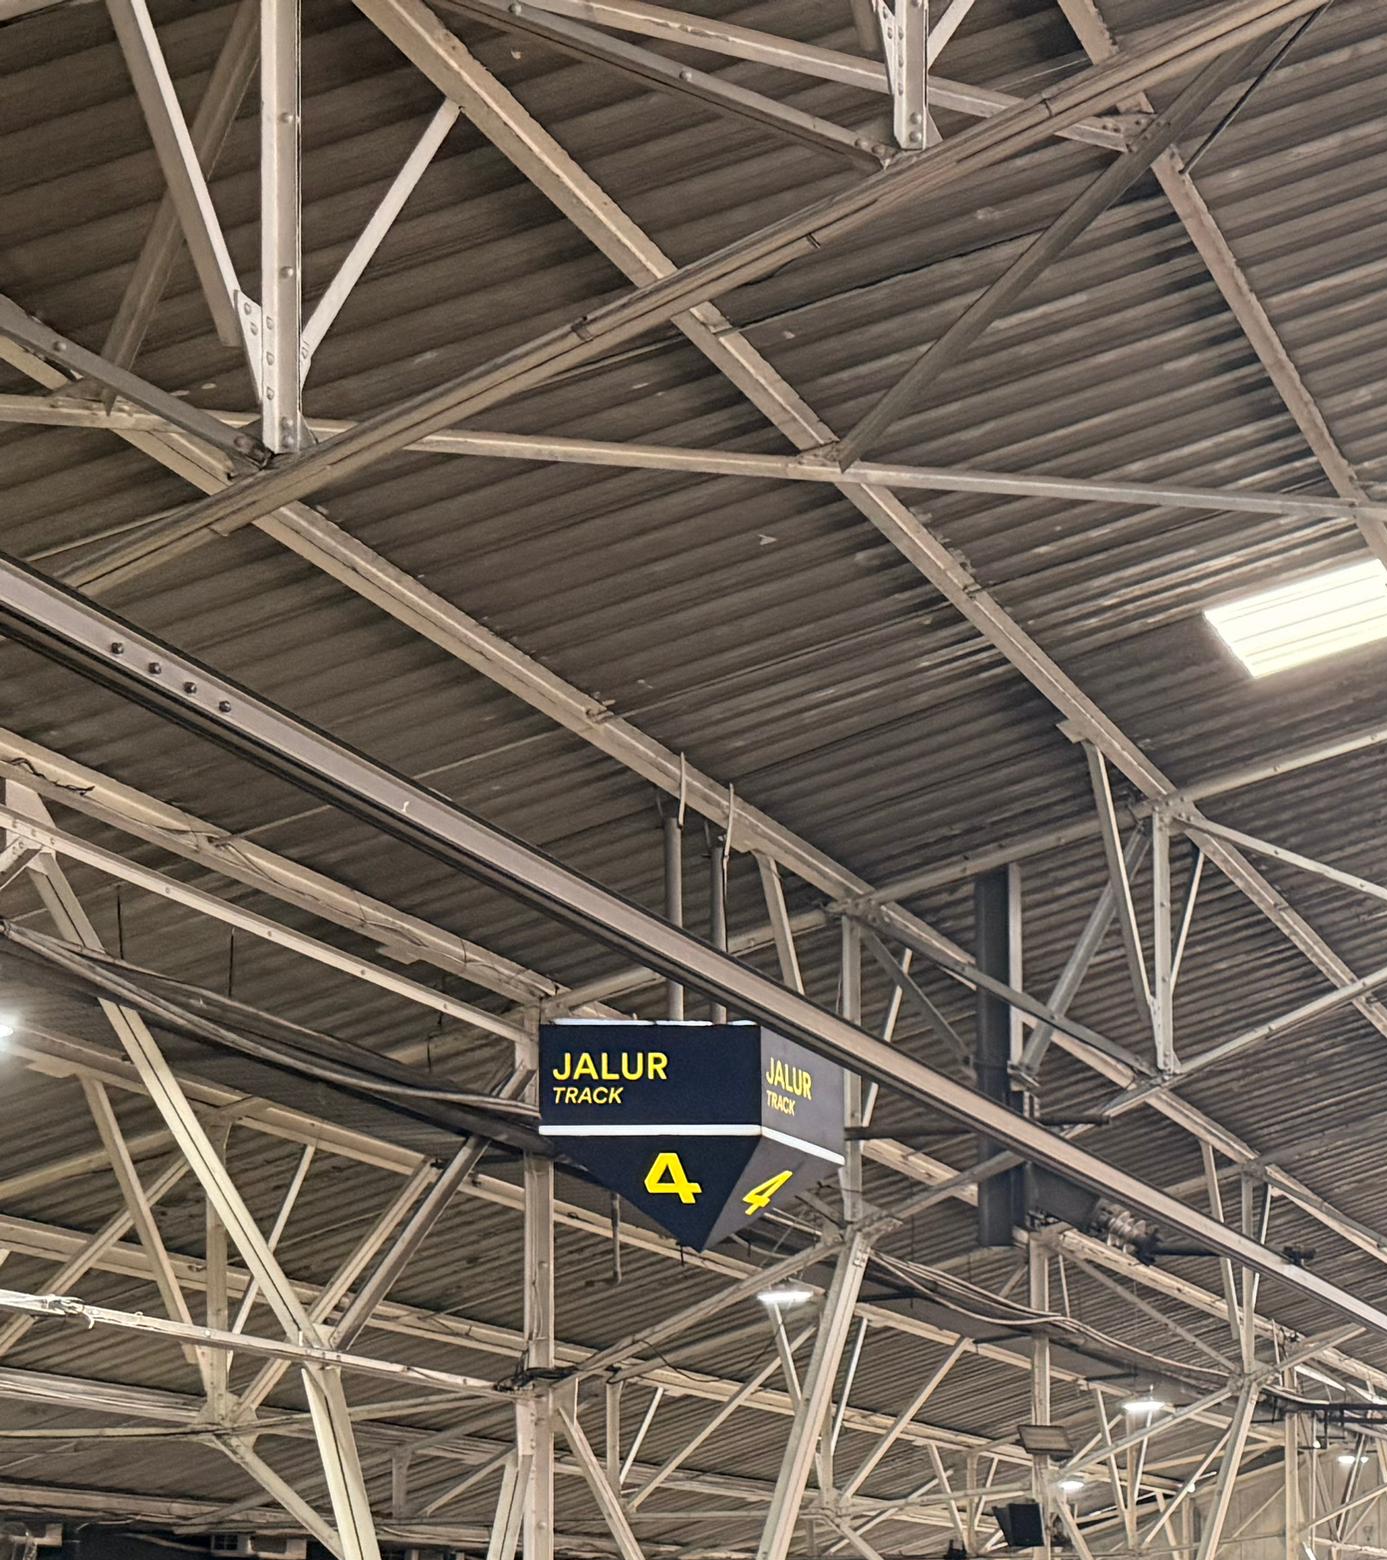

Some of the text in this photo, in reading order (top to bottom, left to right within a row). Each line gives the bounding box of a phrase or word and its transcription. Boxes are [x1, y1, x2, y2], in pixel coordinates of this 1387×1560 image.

[552, 1052, 669, 1081] JALUR
[765, 1056, 812, 1101] JALUR
[552, 1086, 625, 1105] TRACK
[766, 1089, 796, 1117] TRACK
[643, 1152, 703, 1205] 4
[742, 1169, 794, 1216] 4
